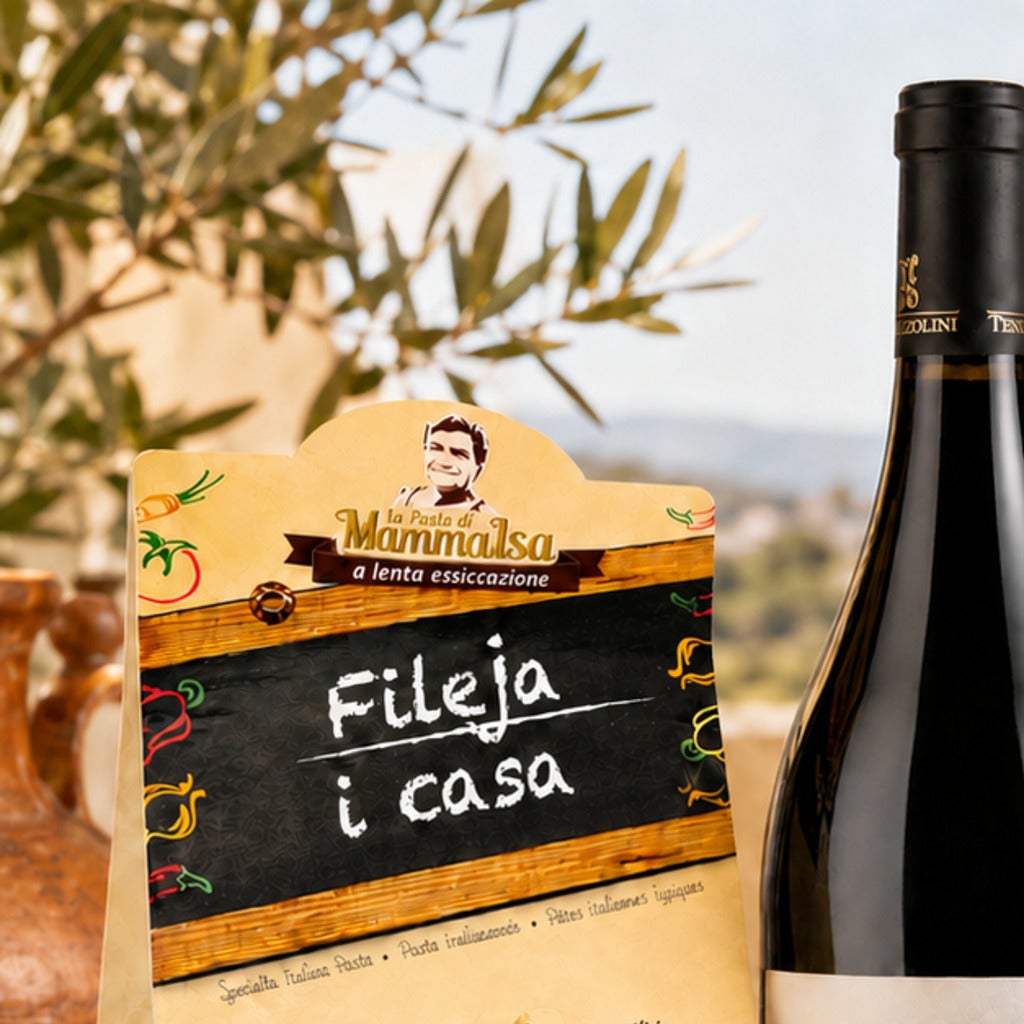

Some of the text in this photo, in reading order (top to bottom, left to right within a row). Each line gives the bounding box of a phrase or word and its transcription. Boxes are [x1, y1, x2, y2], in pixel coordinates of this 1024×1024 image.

[410, 510, 452, 527] Pasta
[458, 512, 473, 528] di
[353, 562, 550, 588] a lenta essiccazione
[328, 633, 560, 743] Fileja
[337, 751, 575, 838] i casa
[334, 953, 374, 975] Pasta
[398, 939, 439, 959] Pasta
